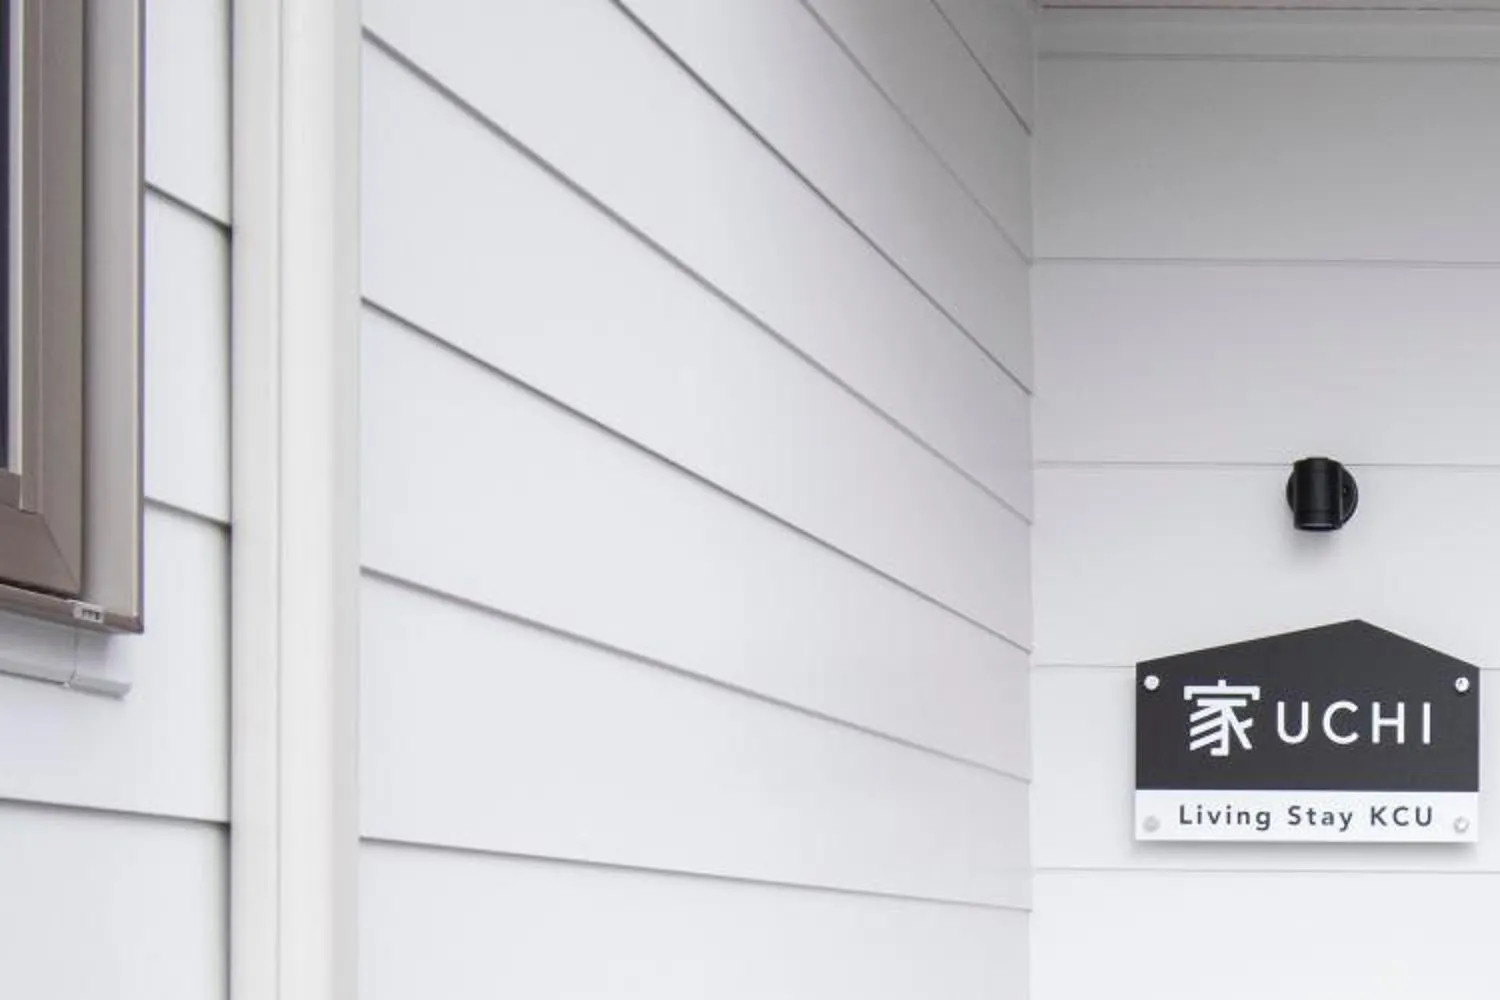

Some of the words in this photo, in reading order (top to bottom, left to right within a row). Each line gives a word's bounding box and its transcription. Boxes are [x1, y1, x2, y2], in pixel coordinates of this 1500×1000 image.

[1184, 679, 1260, 756] 家
[1276, 701, 1432, 745] UCHI
[1178, 804, 1272, 832] Living
[1287, 804, 1353, 832] Stay
[1370, 805, 1433, 827] KCU
